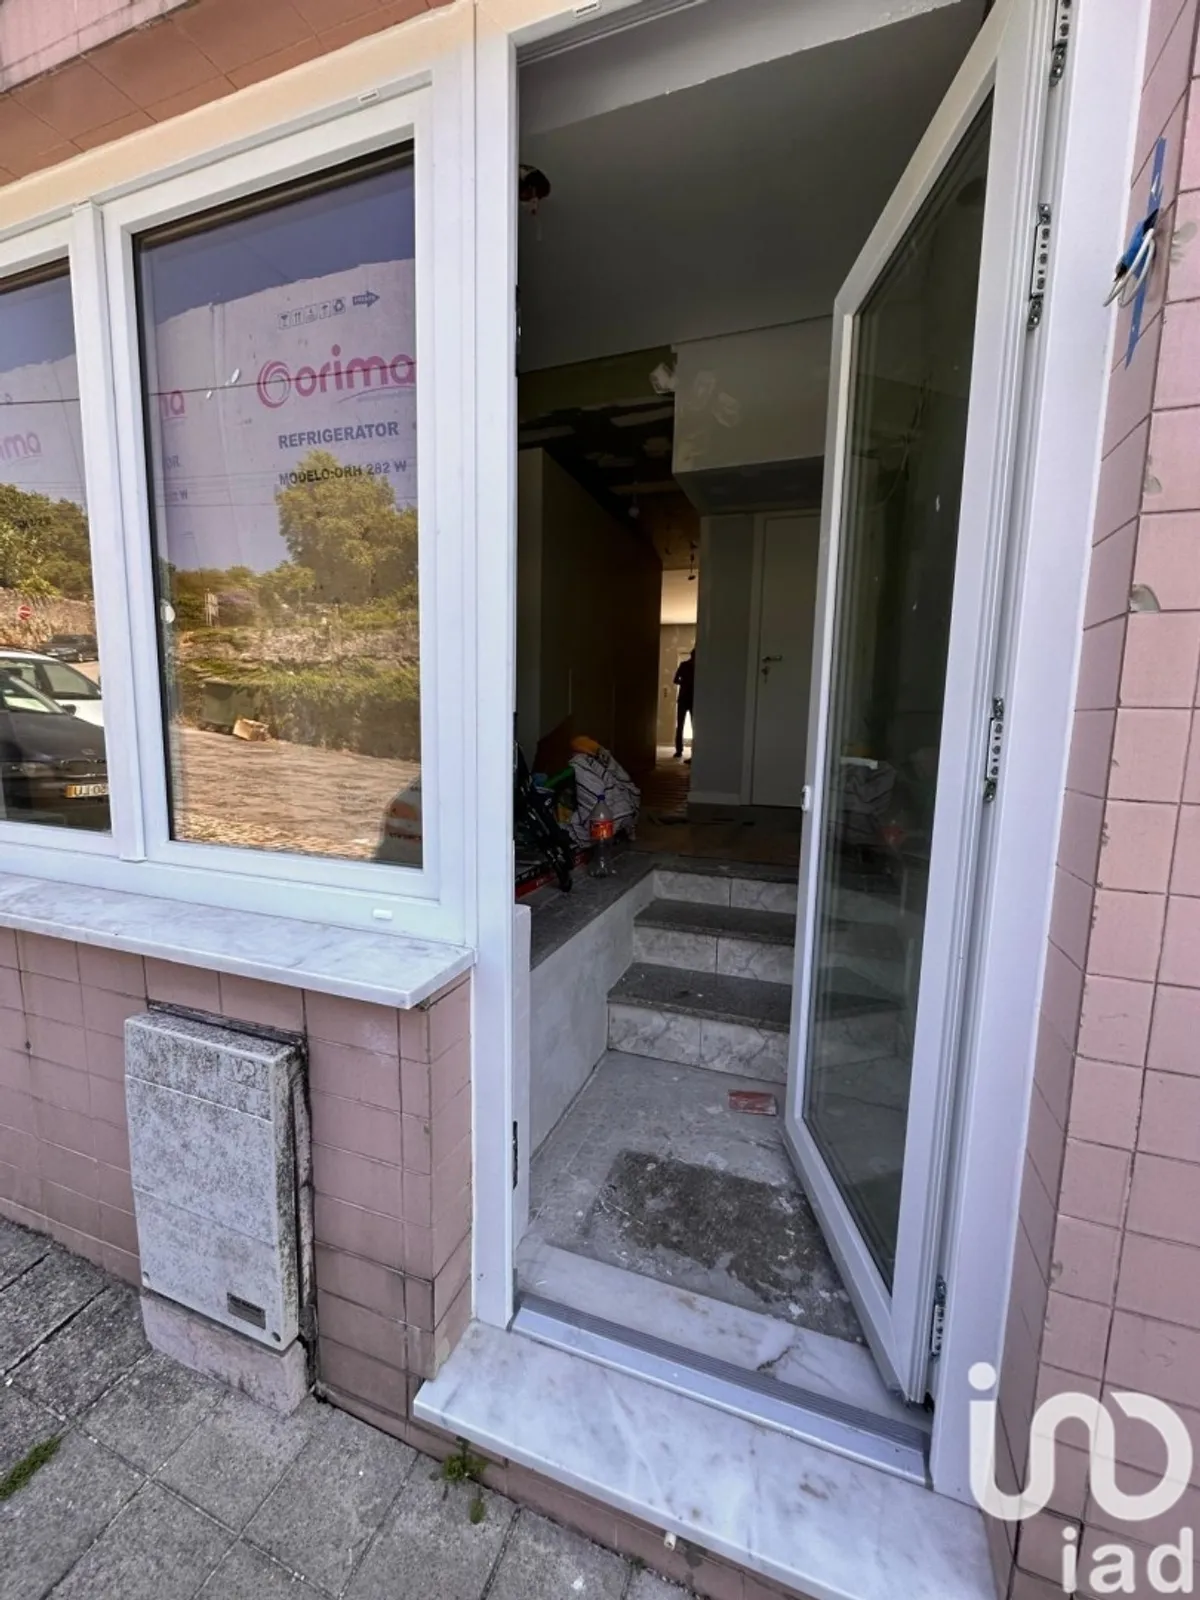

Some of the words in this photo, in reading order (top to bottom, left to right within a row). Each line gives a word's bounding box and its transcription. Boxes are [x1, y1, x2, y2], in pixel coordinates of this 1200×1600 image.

[278, 421, 400, 449] REFRIGERATOR
[366, 462, 391, 476] 282
[394, 459, 407, 473] W
